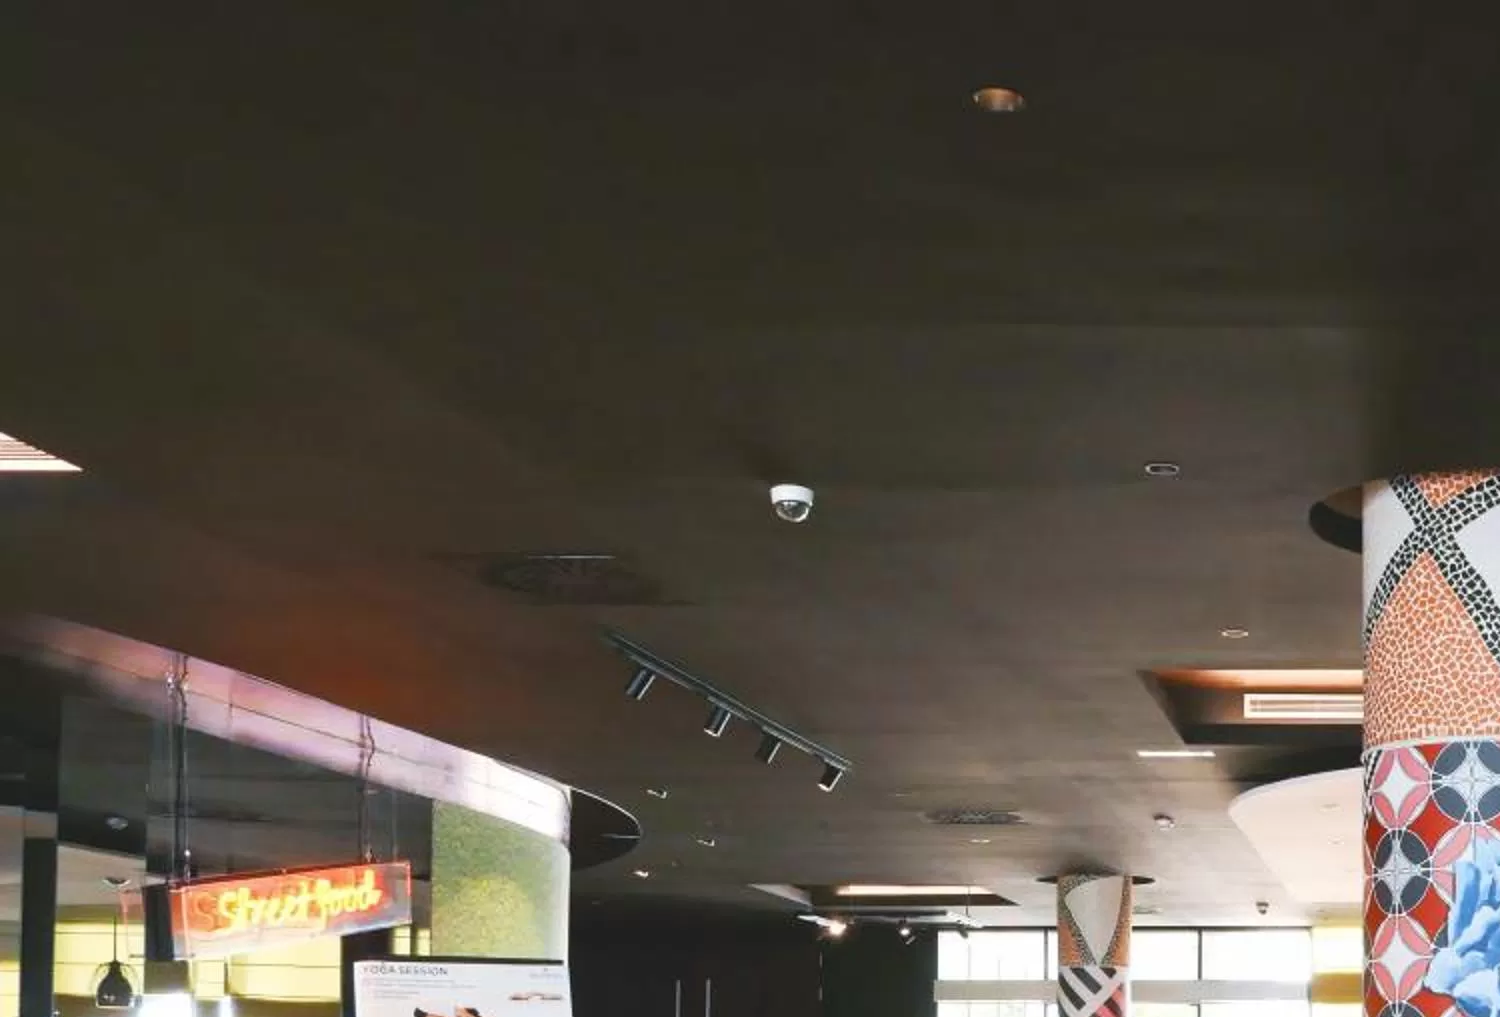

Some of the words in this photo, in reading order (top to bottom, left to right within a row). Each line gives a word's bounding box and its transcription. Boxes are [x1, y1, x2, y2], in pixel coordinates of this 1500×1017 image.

[215, 884, 312, 935] Street
[363, 964, 397, 976] YOGA
[398, 965, 449, 977] SESSION
